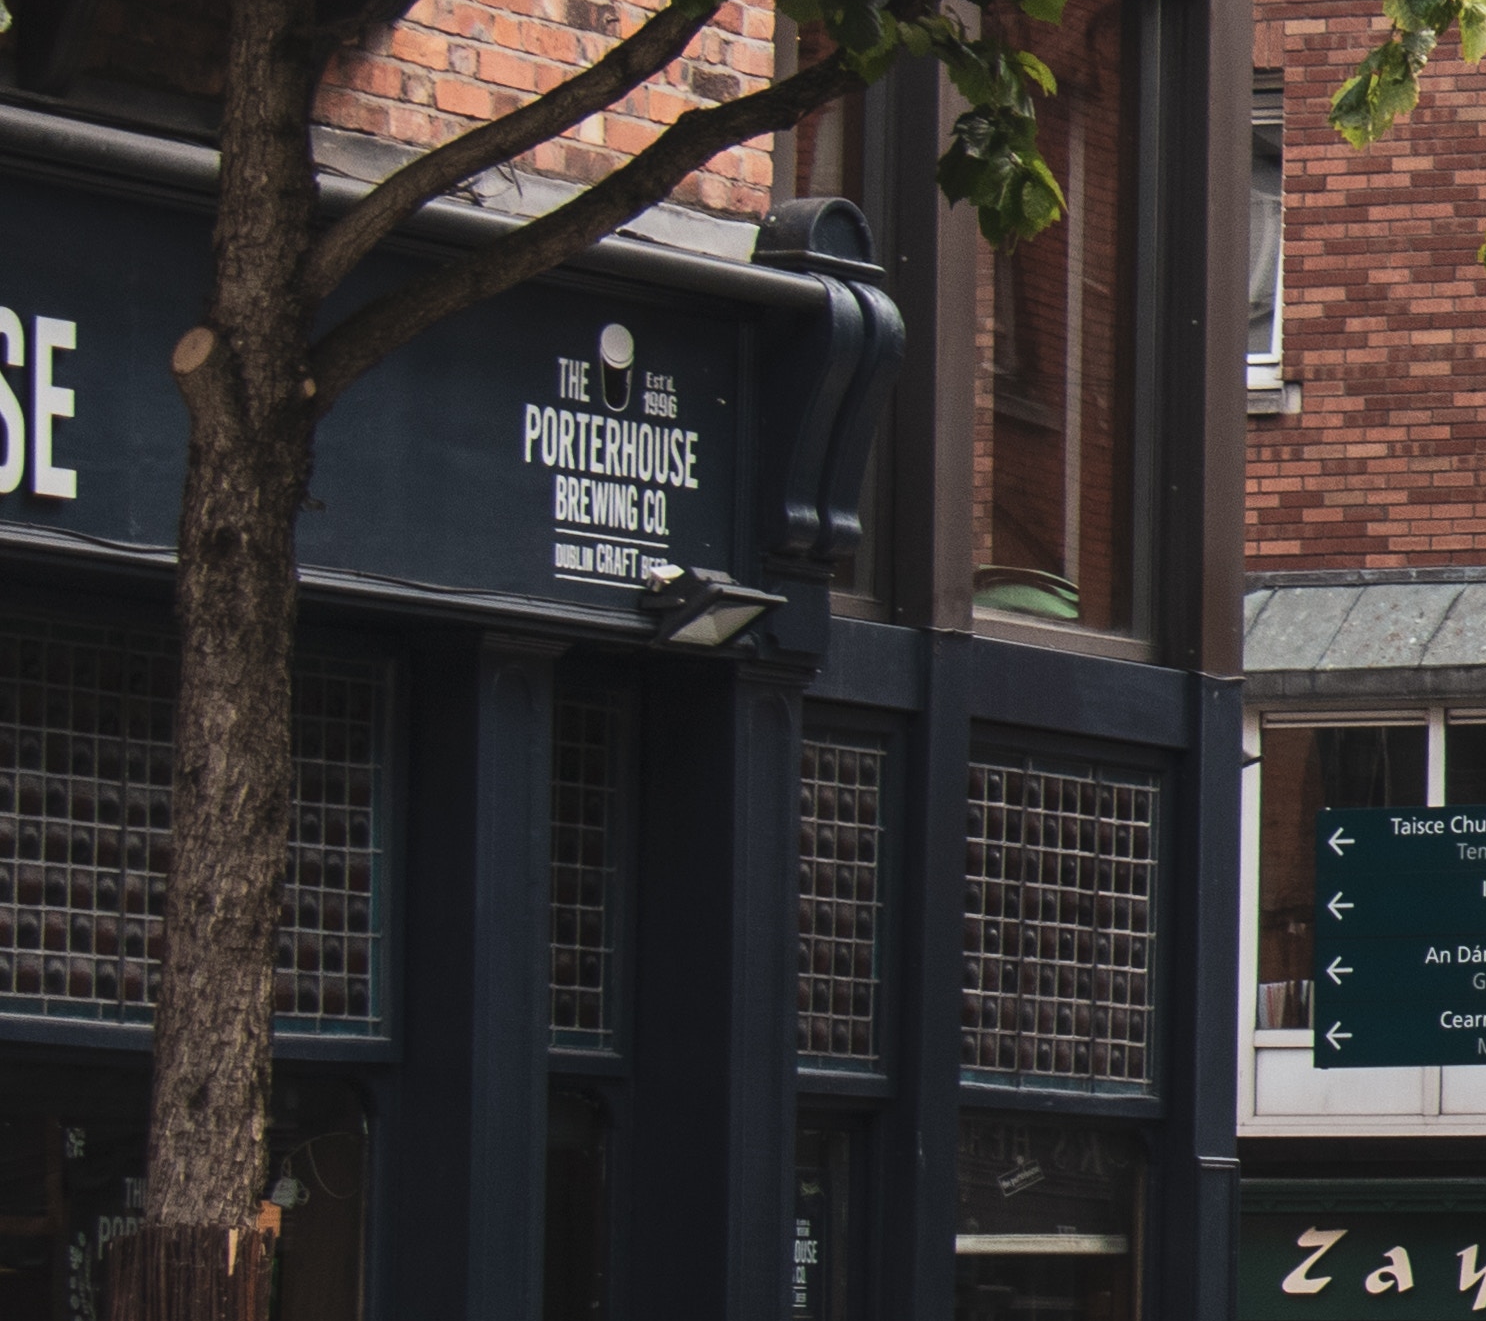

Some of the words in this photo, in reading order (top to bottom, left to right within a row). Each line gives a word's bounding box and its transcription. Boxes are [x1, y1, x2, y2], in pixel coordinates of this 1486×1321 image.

[558, 357, 590, 403] THE
[643, 391, 677, 419] 1996
[525, 402, 698, 489] PORTERHOUSE
[554, 474, 638, 531] BREWING
[643, 488, 669, 535] CO.
[554, 542, 593, 572] DUBLIN
[596, 543, 638, 579] CRAFT
[1391, 817, 1445, 835] Taisce
[1424, 946, 1452, 965] An
